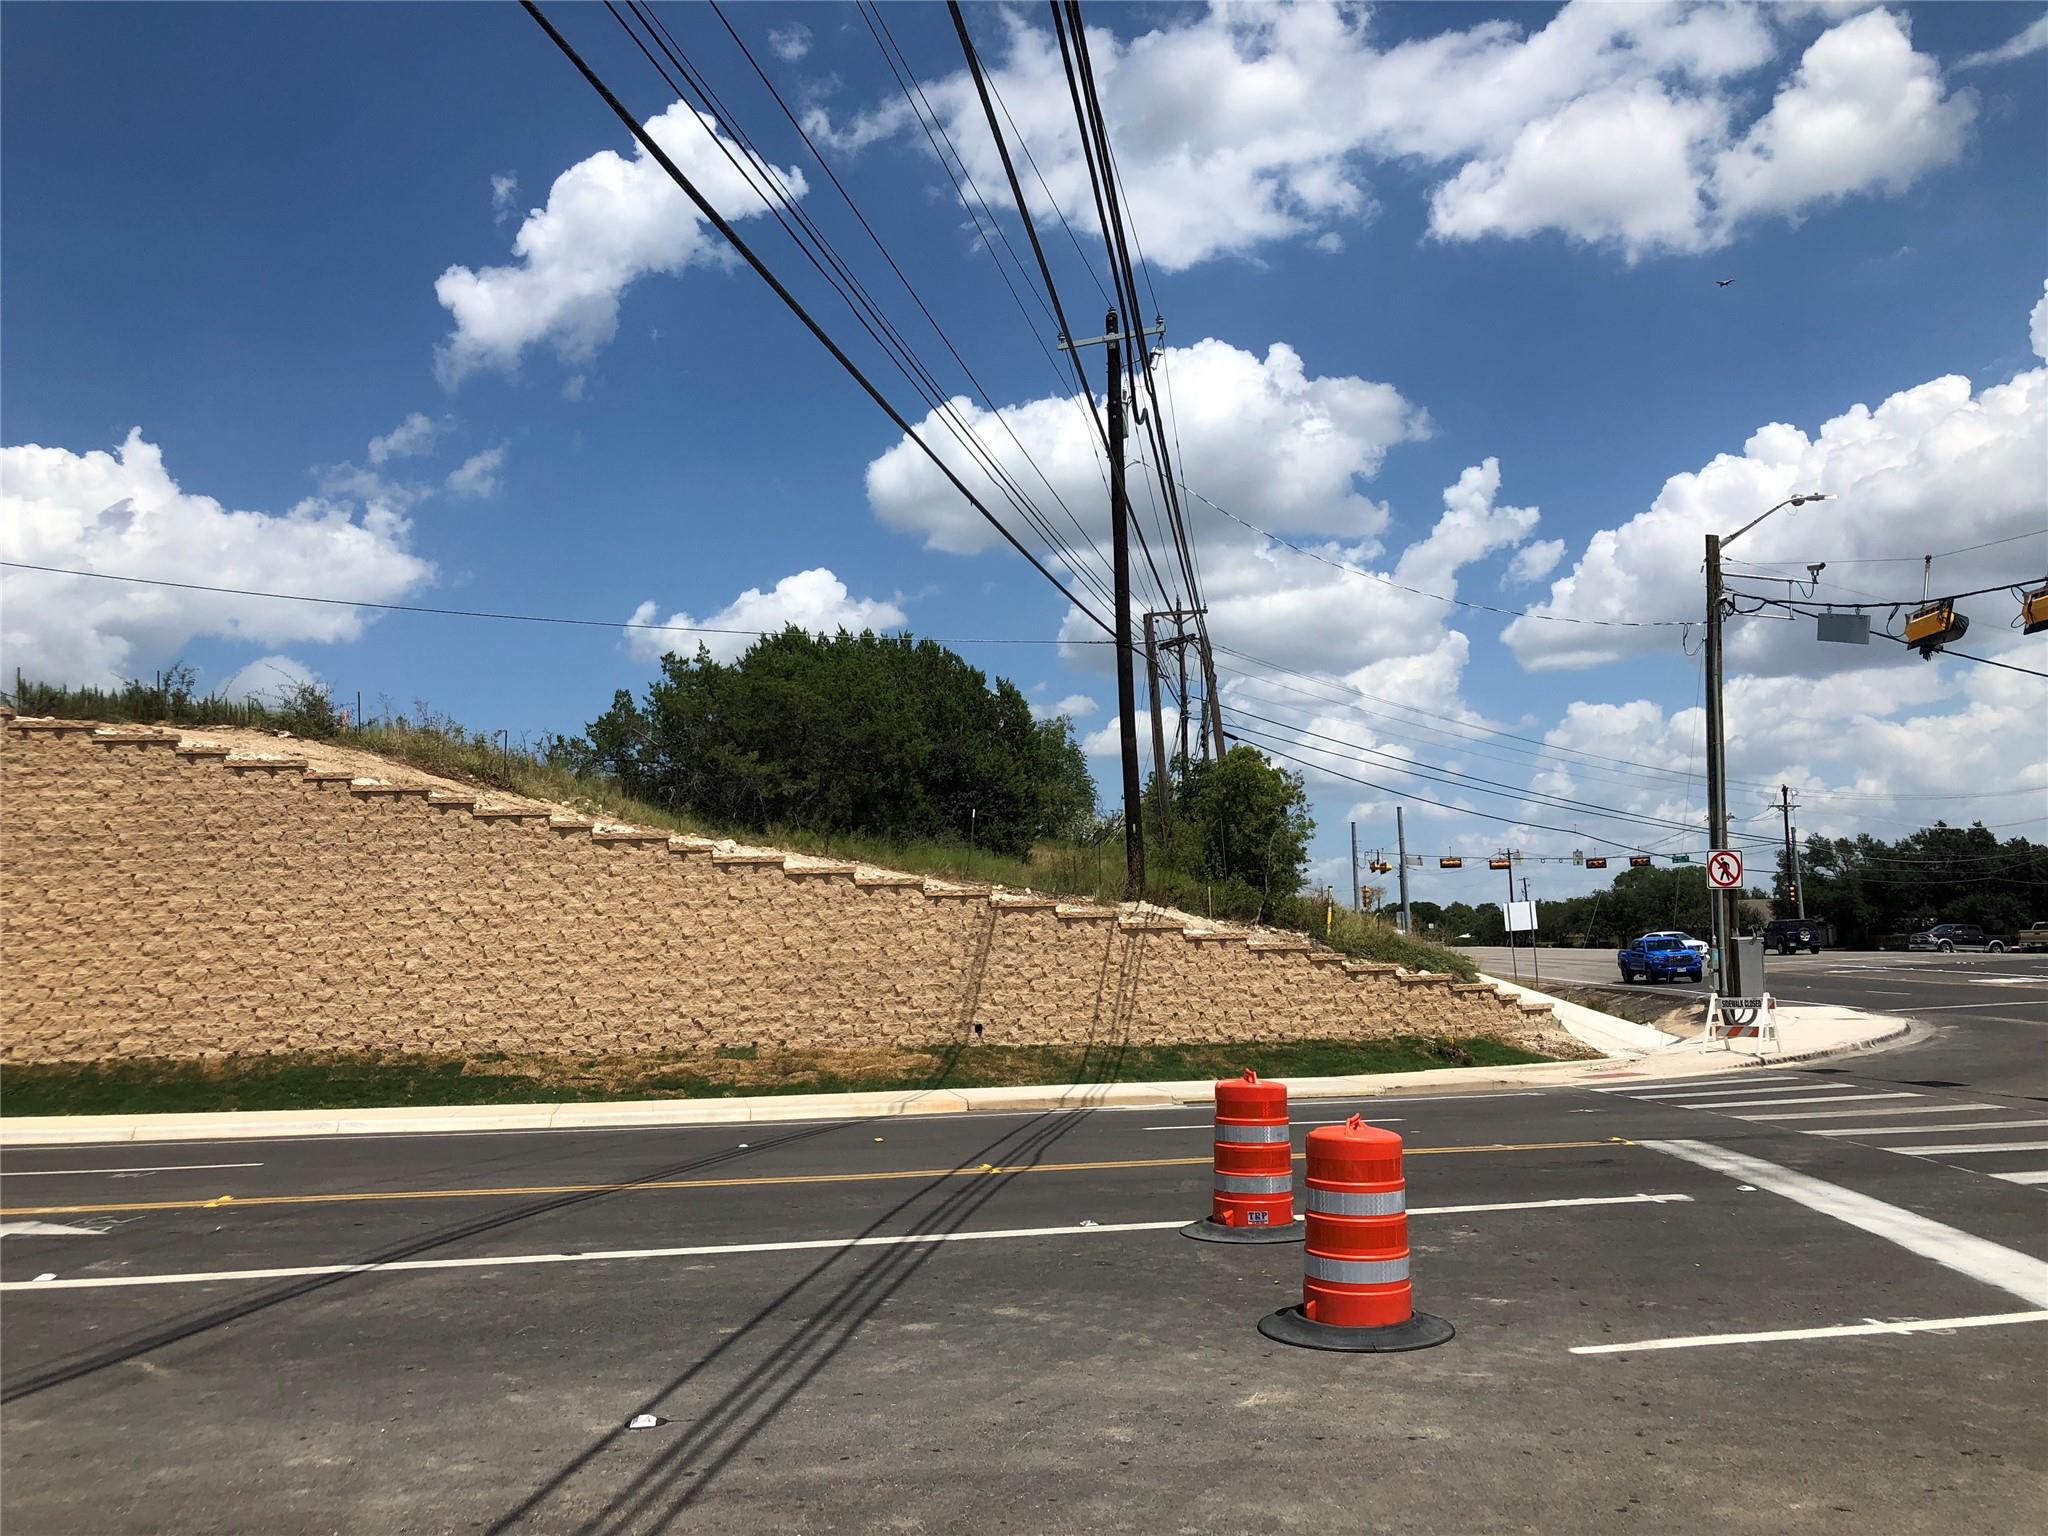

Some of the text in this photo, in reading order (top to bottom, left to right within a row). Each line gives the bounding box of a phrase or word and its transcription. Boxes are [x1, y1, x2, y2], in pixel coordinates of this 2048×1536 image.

[1721, 999, 1762, 1008] SIDEWALK CLOSED
[1248, 1212, 1267, 1220] TRP
